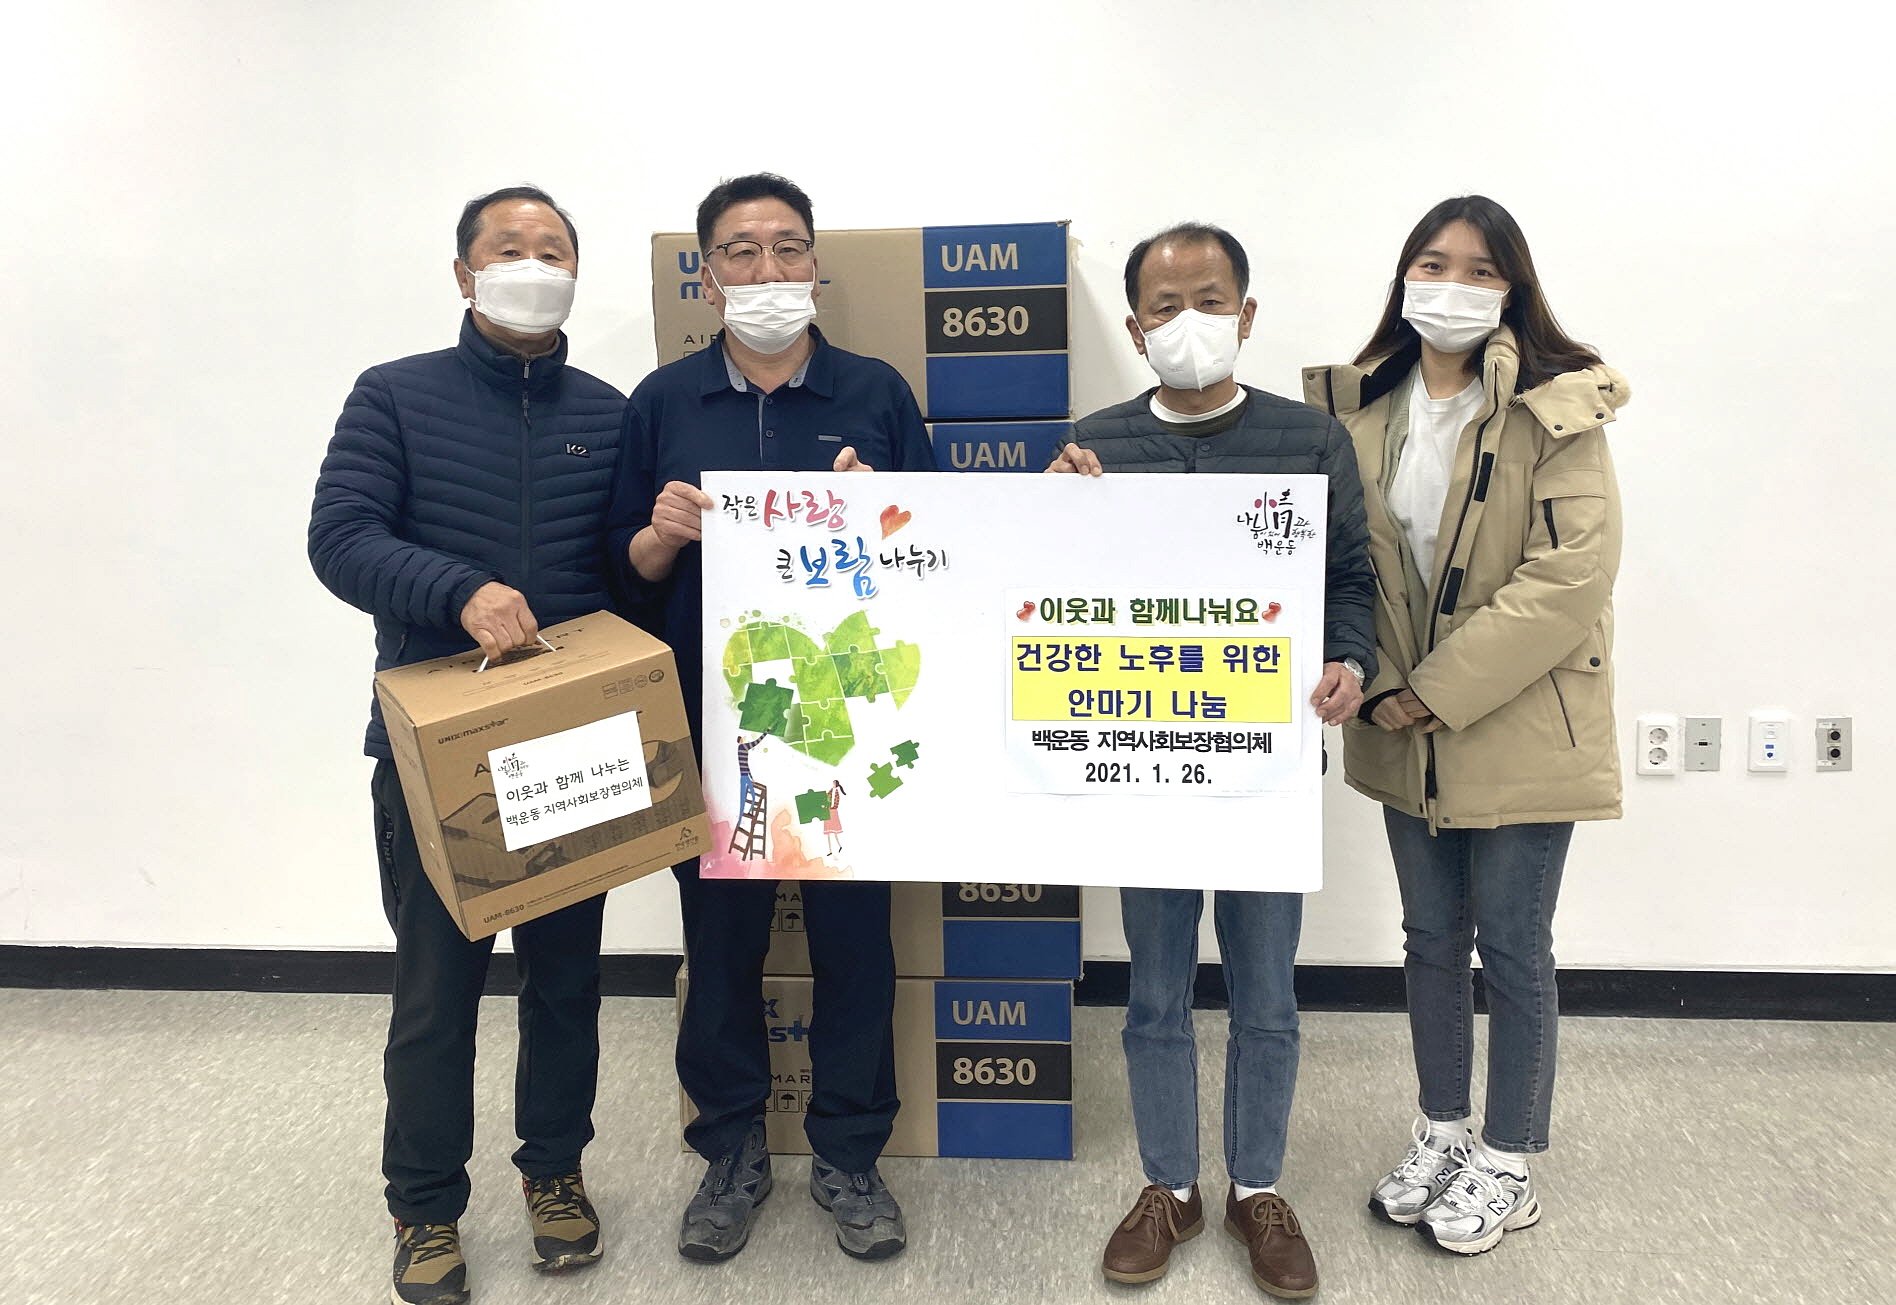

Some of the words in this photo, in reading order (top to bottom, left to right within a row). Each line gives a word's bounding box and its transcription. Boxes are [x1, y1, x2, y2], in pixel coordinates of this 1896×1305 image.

[940, 243, 1019, 273] UAM
[942, 305, 1030, 337] 8630
[950, 441, 1027, 469] UAM
[722, 494, 757, 520] 작은
[763, 489, 846, 530] 사랑
[1257, 538, 1296, 556] 백운동
[776, 548, 793, 579] 큰
[799, 536, 877, 597] 보람
[879, 544, 948, 577] 나누기
[1039, 597, 1116, 624] 이웃과
[1129, 597, 1260, 624] 함께나눠요
[1016, 643, 1102, 673] 건강한
[1119, 644, 1204, 673] 노후를
[1222, 644, 1281, 674] 위한
[1068, 689, 1152, 718] 안마기
[1172, 690, 1227, 719] 나눔
[1032, 730, 1090, 751] 백운동
[1097, 730, 1272, 754] 지역사회보장협의체
[506, 781, 549, 802] 이웃과
[555, 770, 584, 791] 함께
[591, 758, 630, 777] 나누는
[1085, 762, 1140, 783] 2021.
[1152, 763, 1170, 784] 1.
[1181, 764, 1212, 784] 26.
[506, 808, 541, 826] 백운동
[544, 777, 643, 815] 지역사회보장협의체
[958, 882, 1043, 903] 8630
[483, 903, 525, 924] UAM-8630
[952, 1000, 1027, 1027] UAM
[771, 1074, 810, 1084] MAR
[952, 1057, 1037, 1087] 8630
